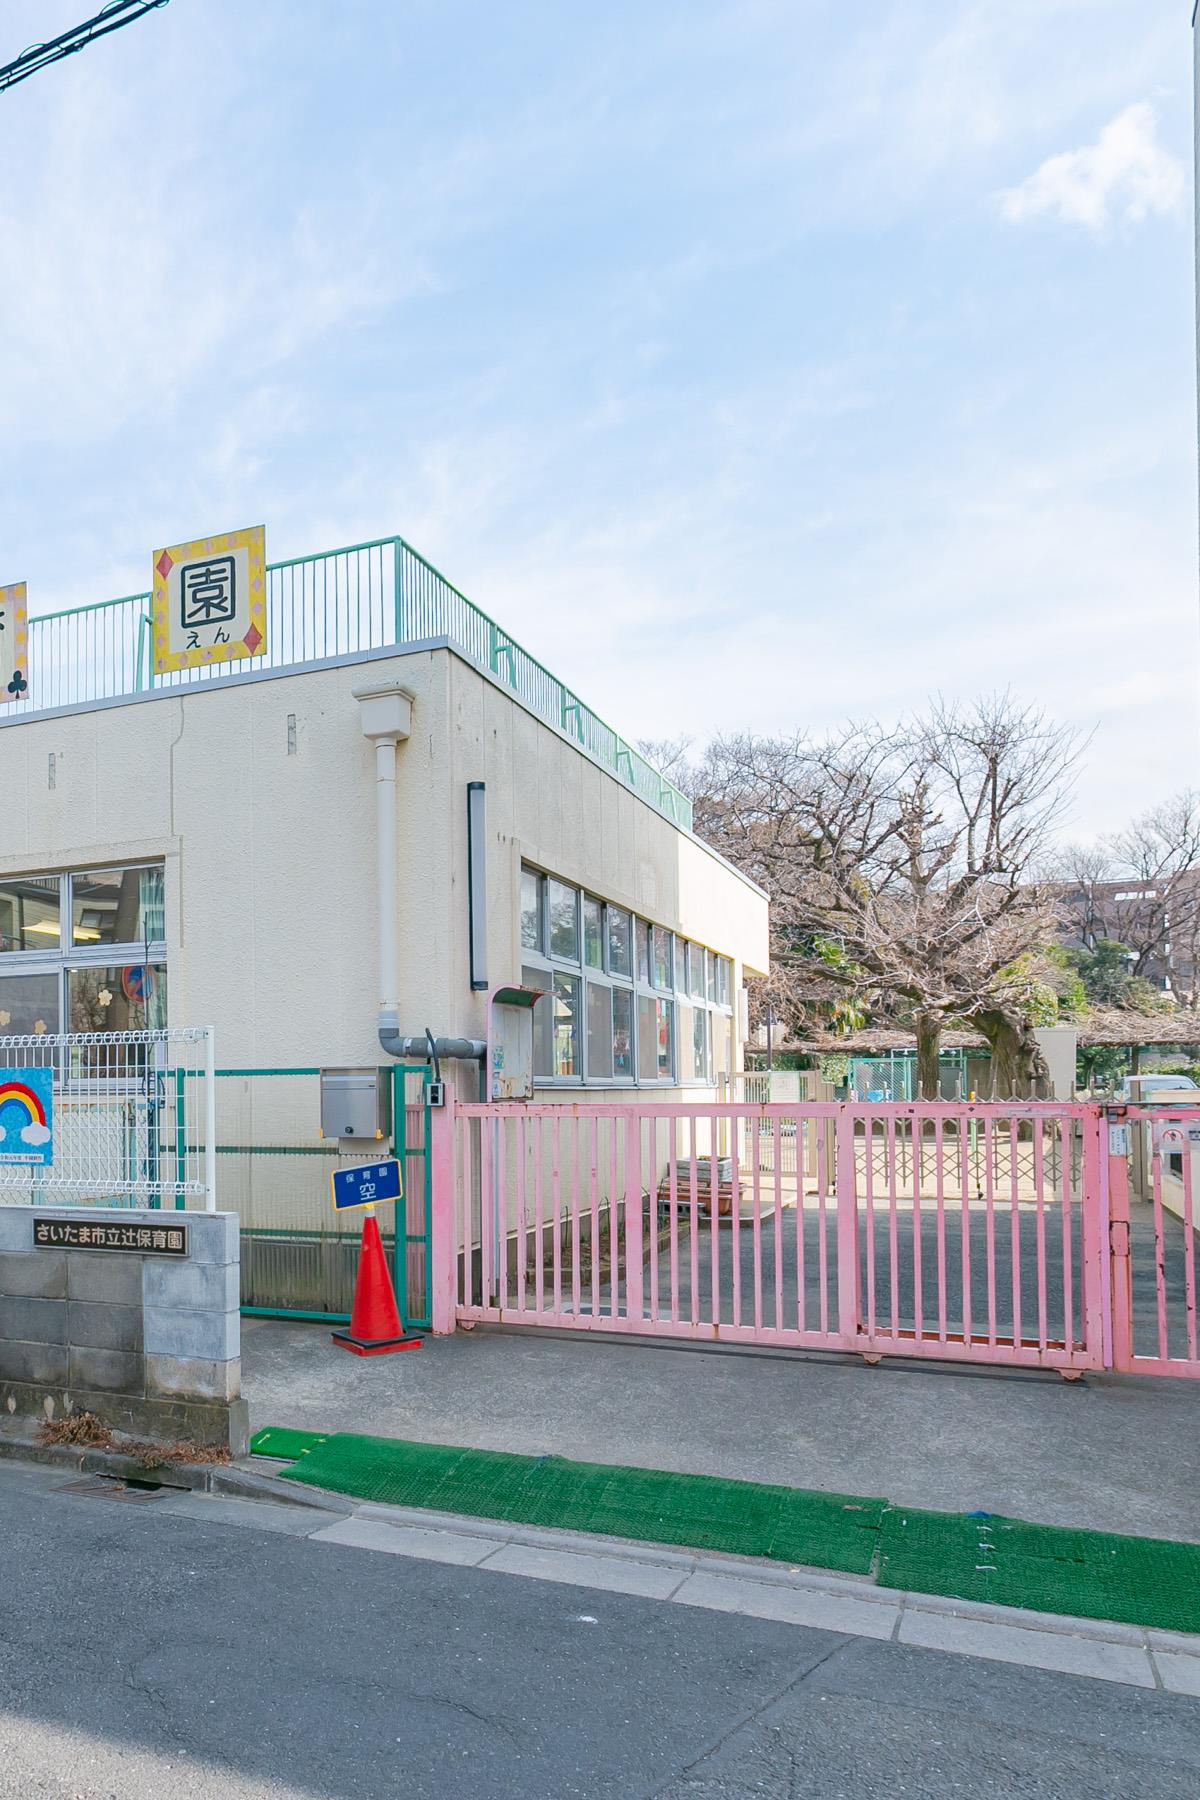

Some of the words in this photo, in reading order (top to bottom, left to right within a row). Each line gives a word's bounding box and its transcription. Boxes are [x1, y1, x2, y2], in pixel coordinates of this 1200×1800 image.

[180, 555, 236, 630] 園
[185, 626, 231, 650] えん
[345, 1167, 388, 1184] 保育園
[359, 1183, 377, 1200] 空
[36, 1223, 183, 1249] さいたま市立辻保育園
